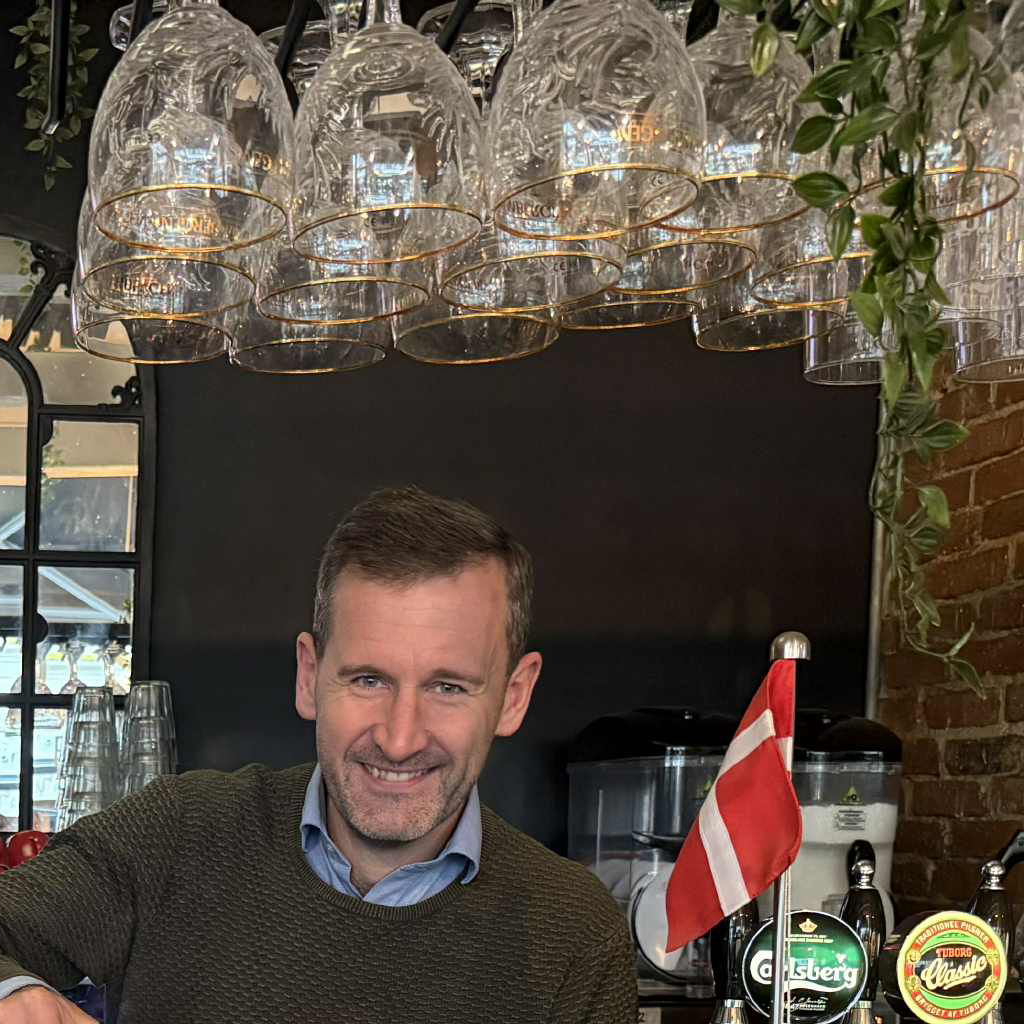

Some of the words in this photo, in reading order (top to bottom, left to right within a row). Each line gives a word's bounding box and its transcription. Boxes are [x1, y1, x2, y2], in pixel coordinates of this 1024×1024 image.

[960, 921, 990, 944] PILSNER
[936, 948, 973, 958] TUBORG
[750, 949, 858, 992] Calsberg
[920, 955, 987, 990] Classic
